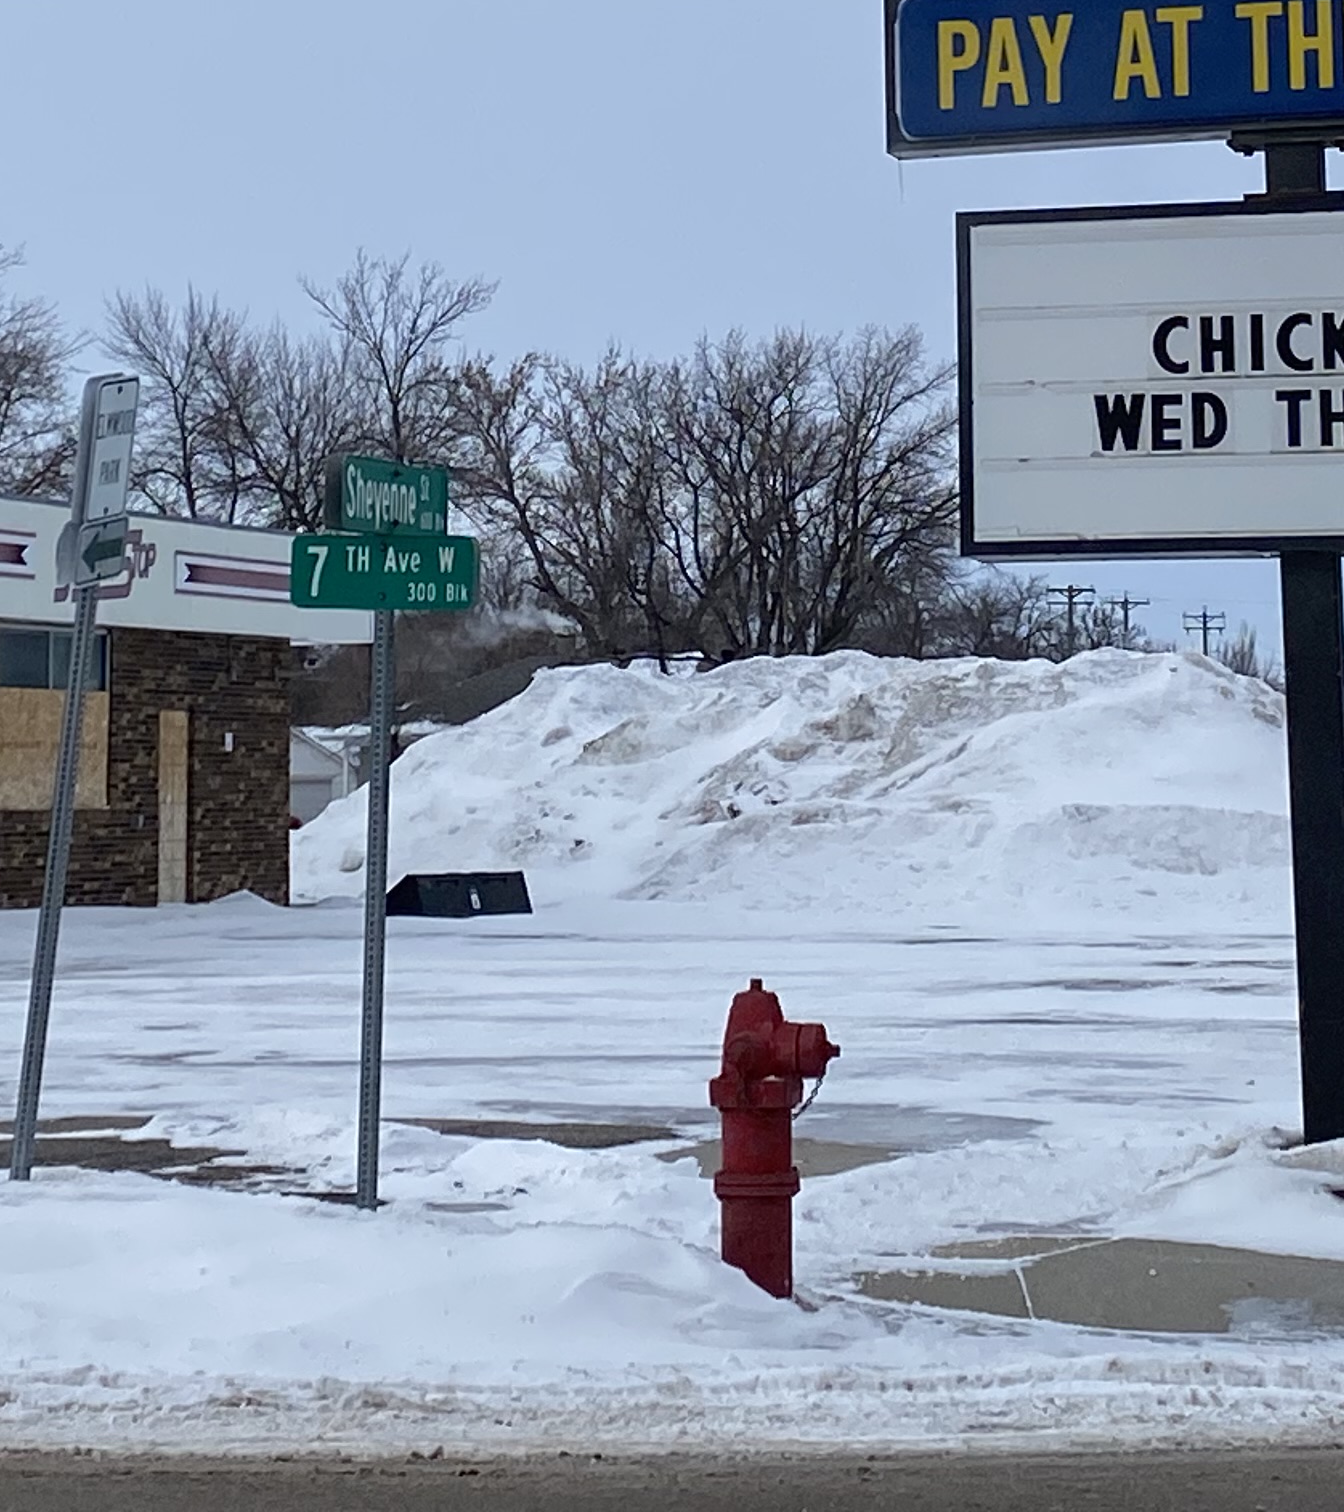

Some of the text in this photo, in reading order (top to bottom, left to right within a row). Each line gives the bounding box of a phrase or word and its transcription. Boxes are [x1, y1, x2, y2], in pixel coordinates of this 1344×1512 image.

[938, 13, 1072, 109] PAY
[1113, 6, 1203, 100] AT
[1093, 392, 1228, 452] WED
[346, 463, 417, 529] Sheyenne
[307, 545, 455, 597] 7 TH Ave W
[408, 582, 468, 602] 300 Blk
